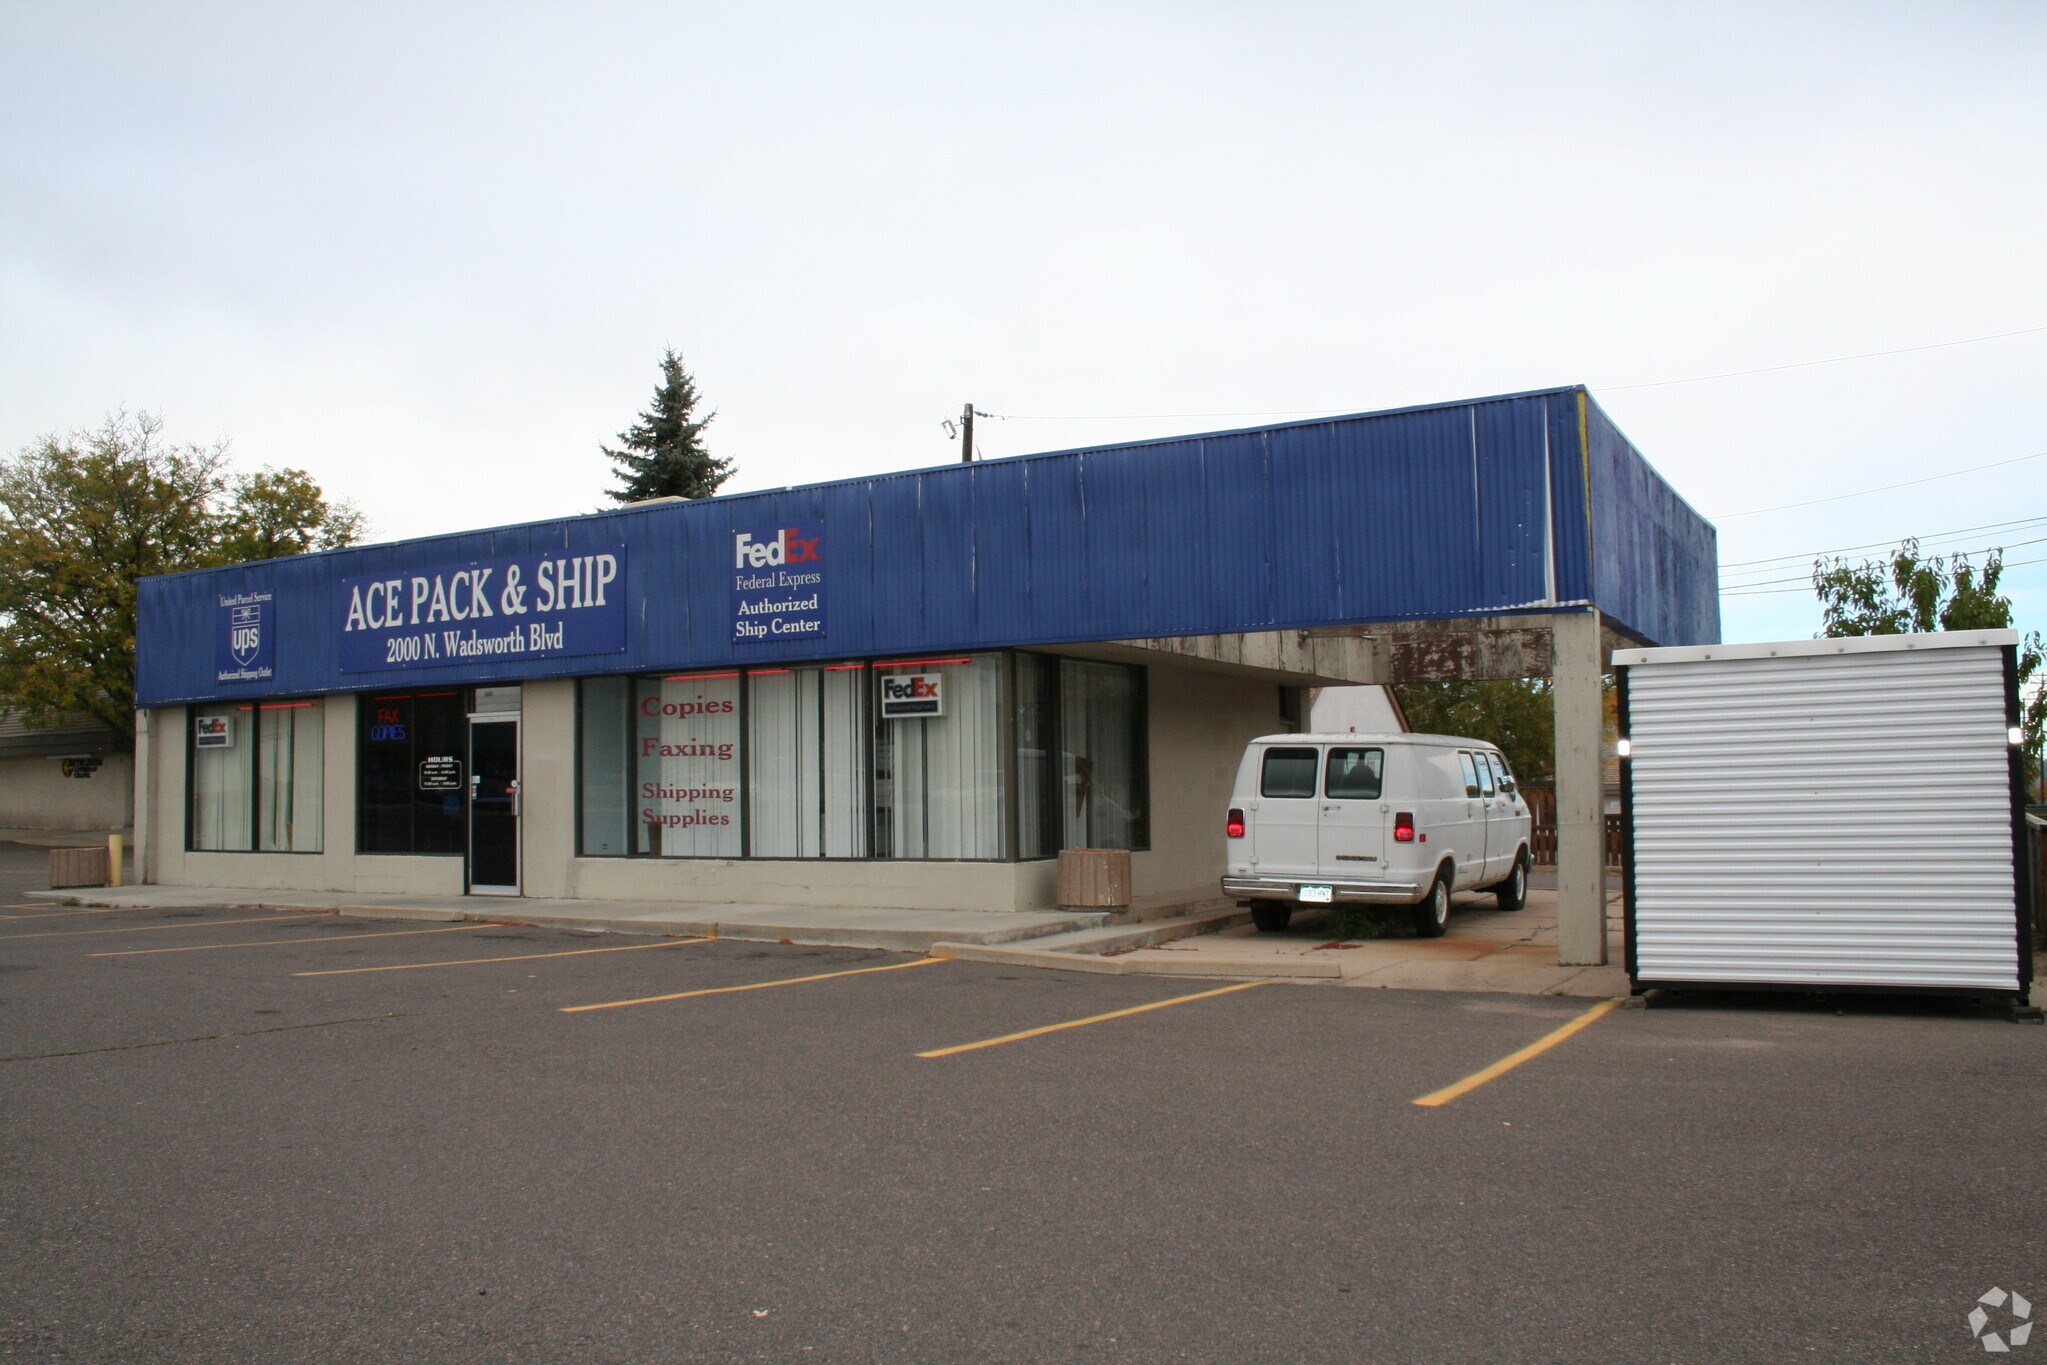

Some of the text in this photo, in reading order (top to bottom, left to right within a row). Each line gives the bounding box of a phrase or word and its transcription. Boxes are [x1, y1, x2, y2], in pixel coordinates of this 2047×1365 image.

[736, 528, 820, 569] FedEx
[736, 571, 821, 591] Federal Express
[220, 592, 272, 606] United Parcel Service
[345, 554, 617, 632] ACE PACK & SHIP
[738, 593, 818, 616] Authorized
[736, 618, 820, 638] Ship Center
[233, 628, 258, 656] ups
[386, 621, 564, 663] 2000 N. Wadsworth Blvd
[259, 667, 272, 677] Outlet
[884, 676, 939, 699] FedEx
[377, 708, 398, 724] FAX
[640, 695, 734, 719] Copies
[198, 718, 226, 735] FedEx
[641, 737, 734, 760] Faxing
[642, 782, 735, 803] Shipping
[642, 808, 730, 829] Supplies
